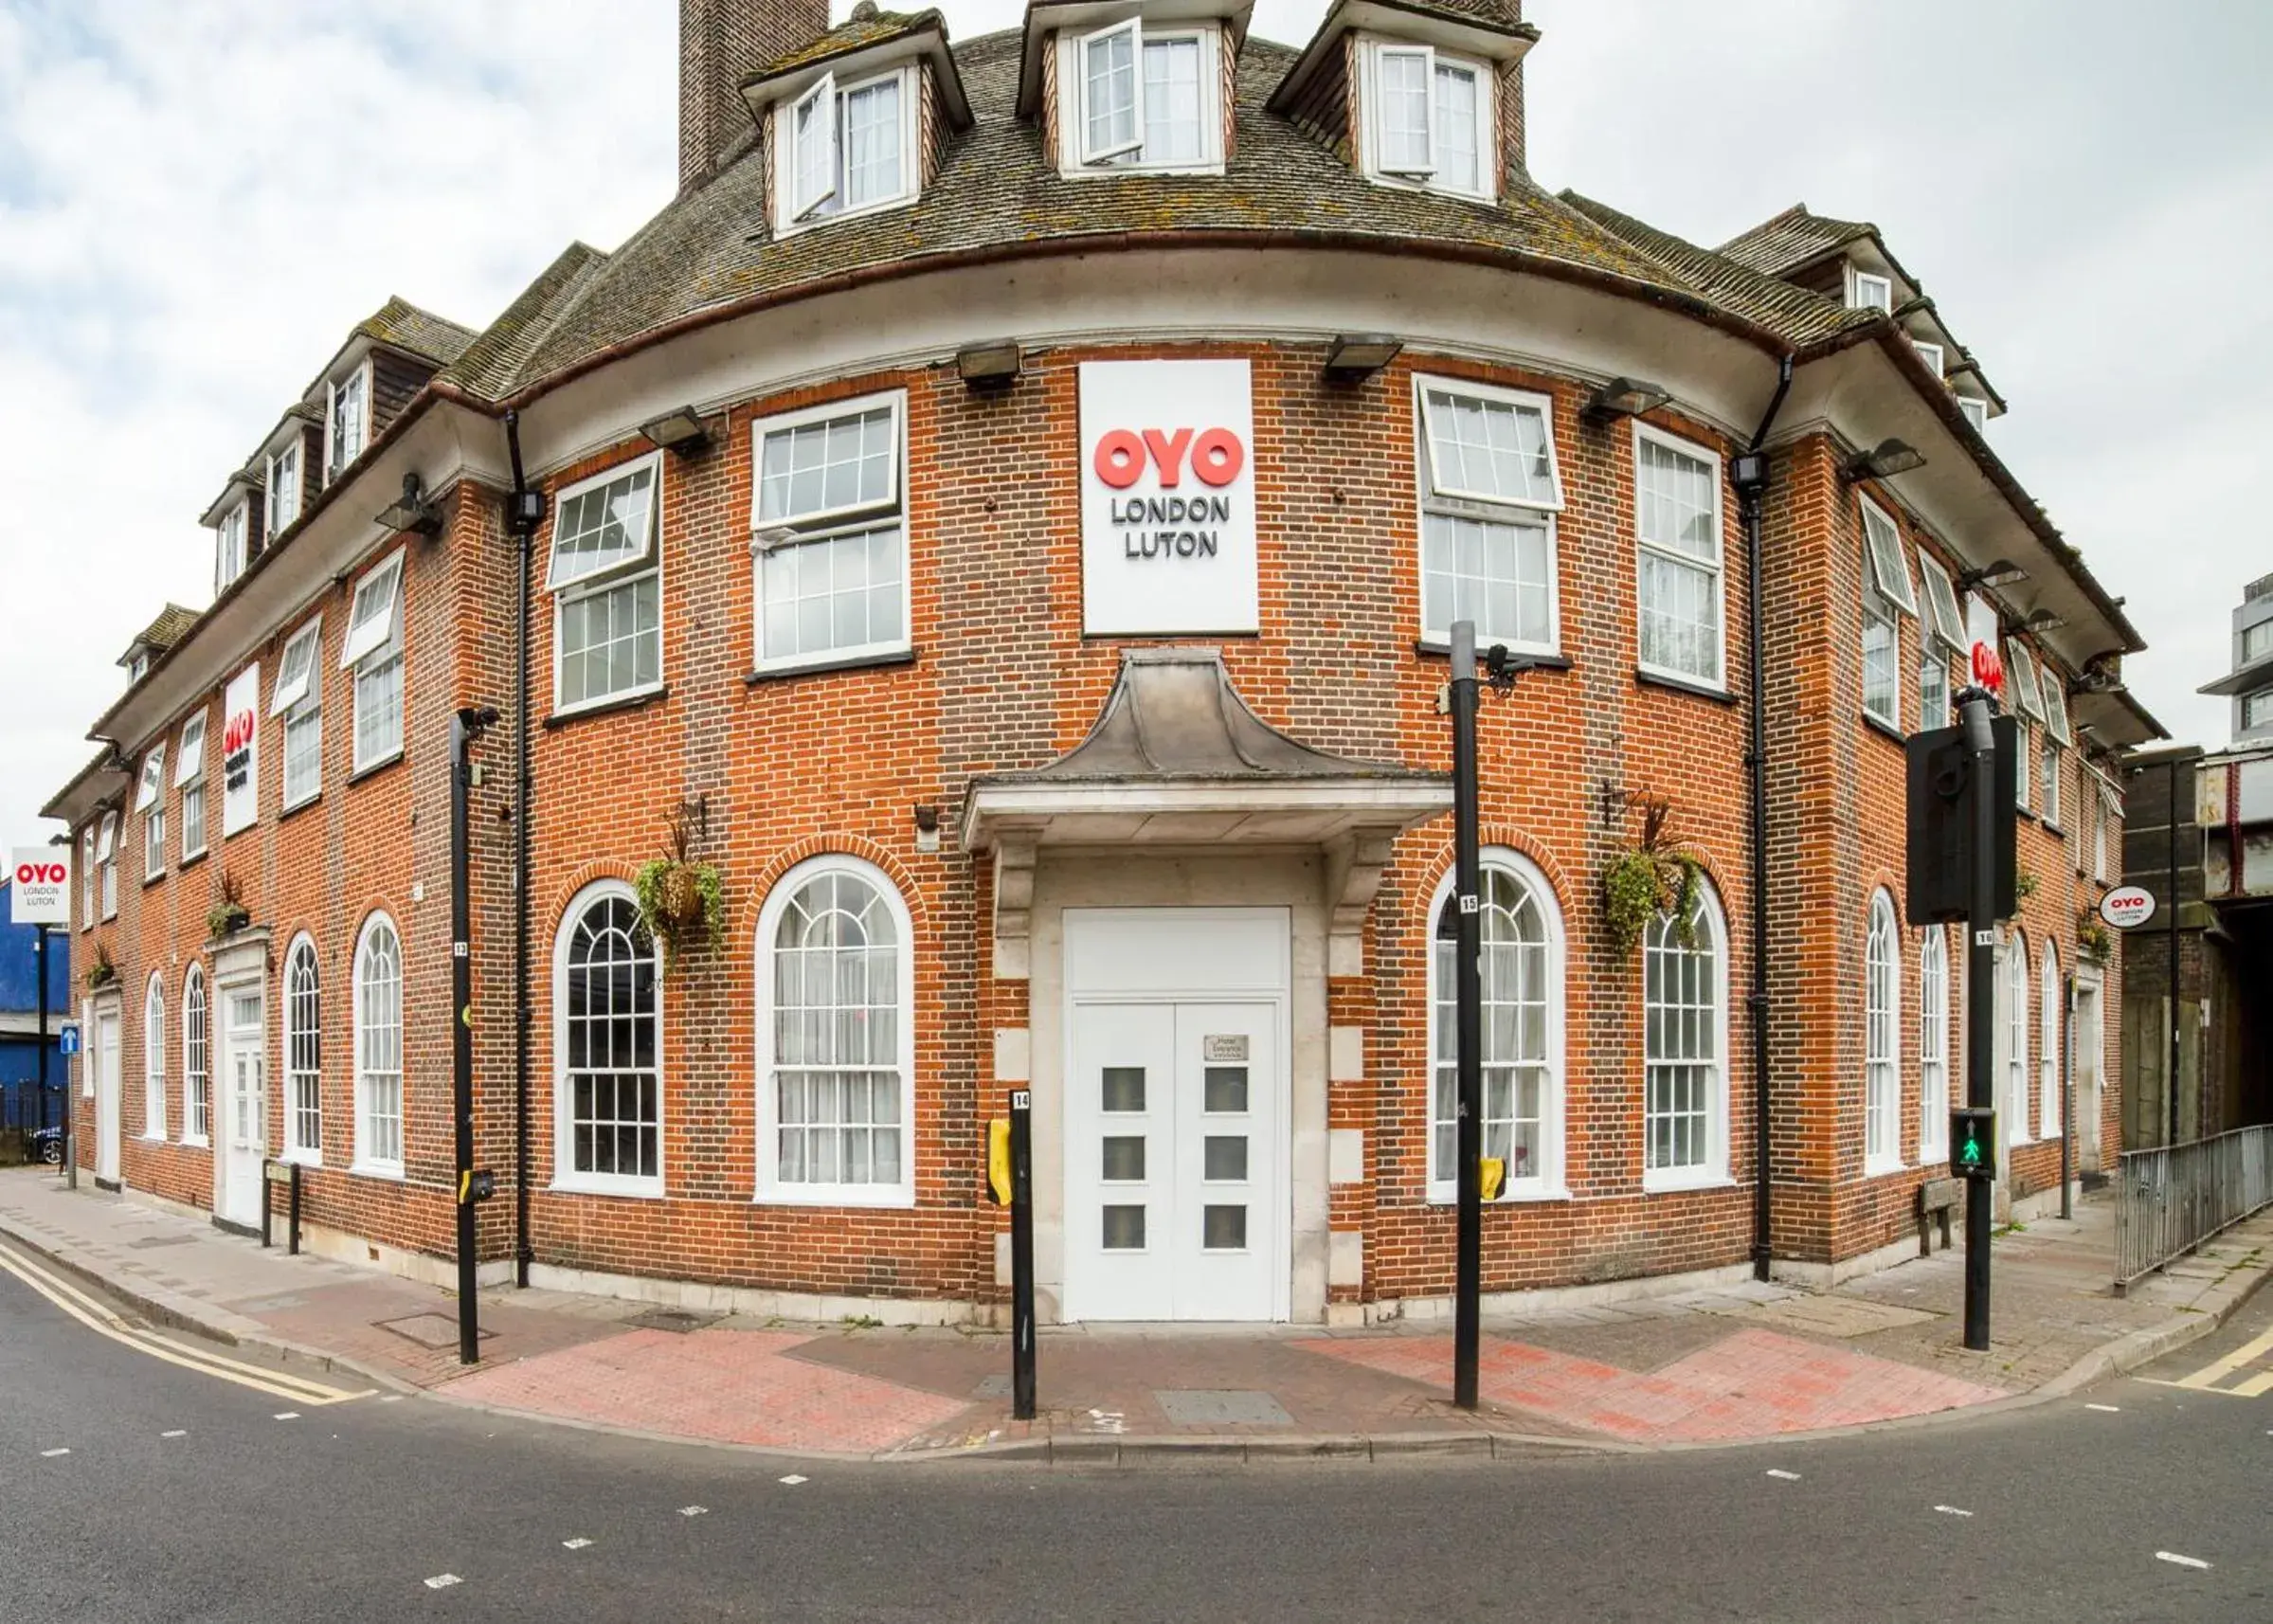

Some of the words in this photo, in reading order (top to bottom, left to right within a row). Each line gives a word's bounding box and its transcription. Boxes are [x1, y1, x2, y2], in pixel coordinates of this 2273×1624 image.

[1093, 427, 1244, 489] OYO
[1111, 496, 1230, 524] LONDON
[1125, 531, 1218, 559] LUTON
[16, 863, 66, 884] OYO
[1463, 897, 1476, 910] 15
[2111, 897, 2145, 909] OYO
[1017, 1093, 1029, 1106] 14
